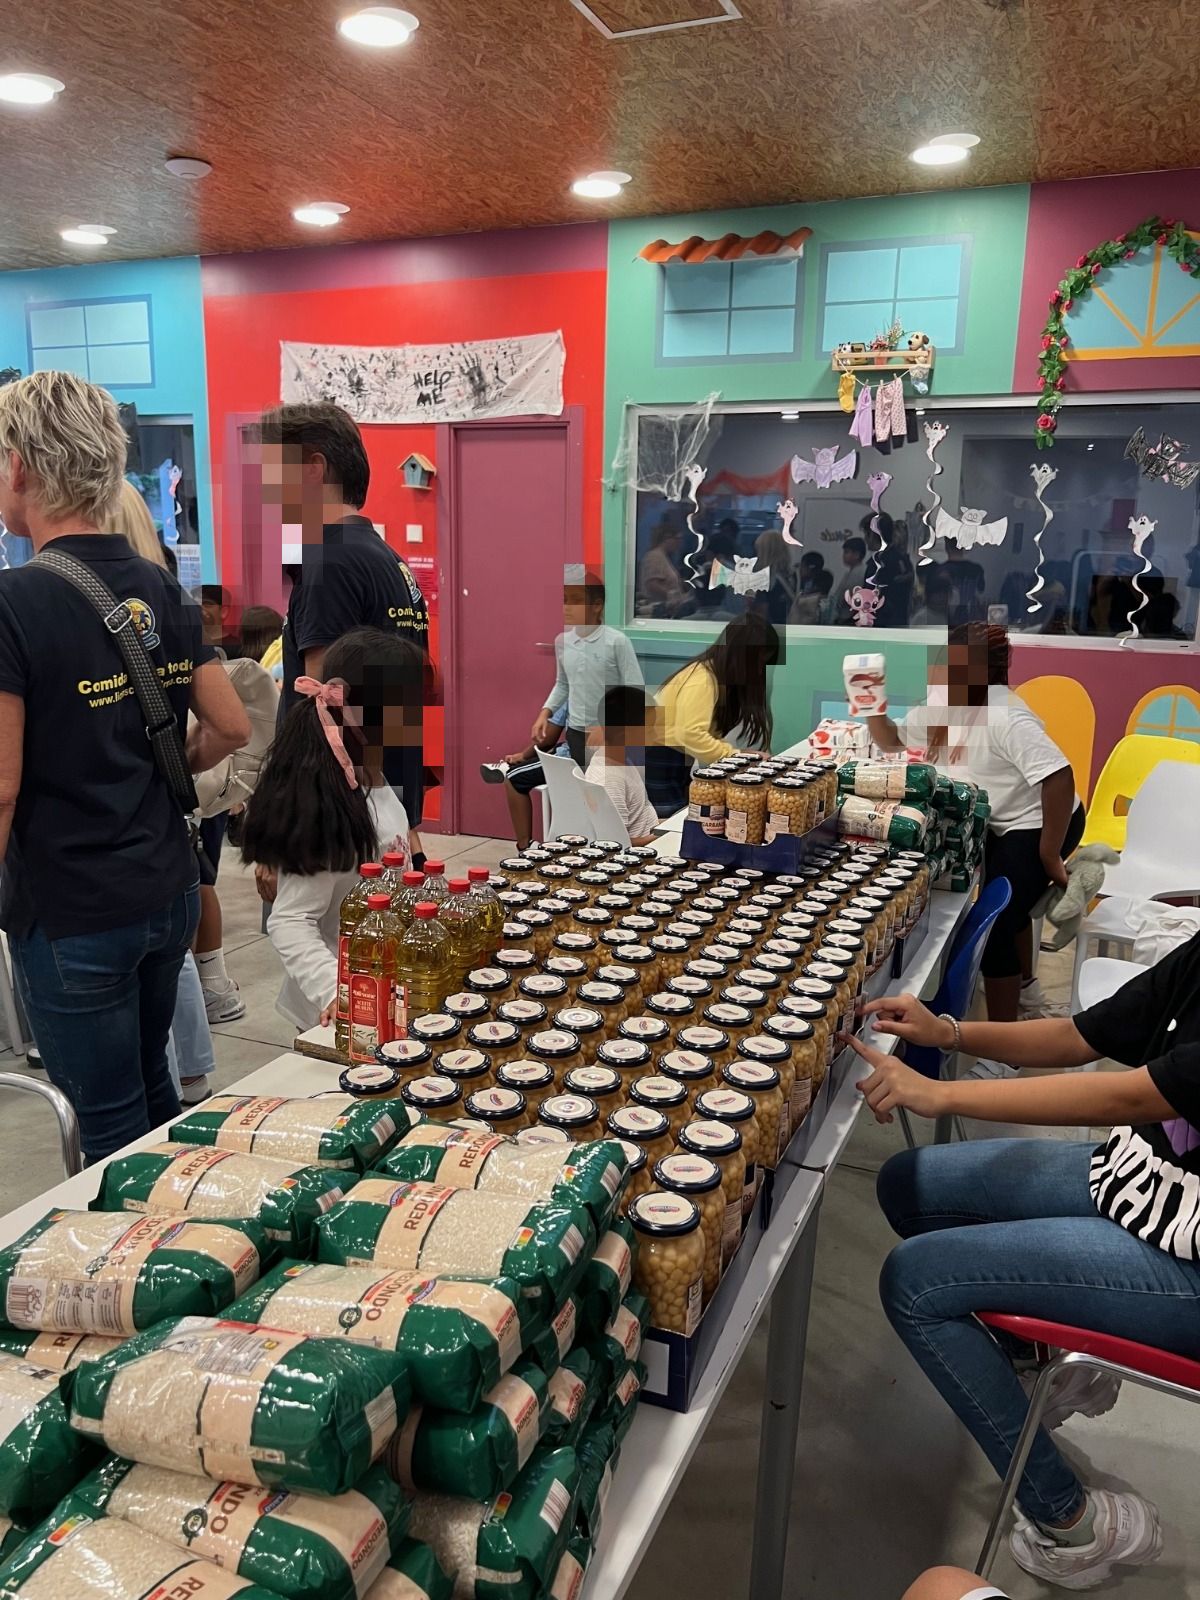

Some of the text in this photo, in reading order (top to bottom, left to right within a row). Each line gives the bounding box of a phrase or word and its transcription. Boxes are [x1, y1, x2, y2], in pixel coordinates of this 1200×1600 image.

[412, 369, 455, 391] HELP
[416, 388, 446, 406] ME
[352, 1521, 386, 1570] REDONDO
